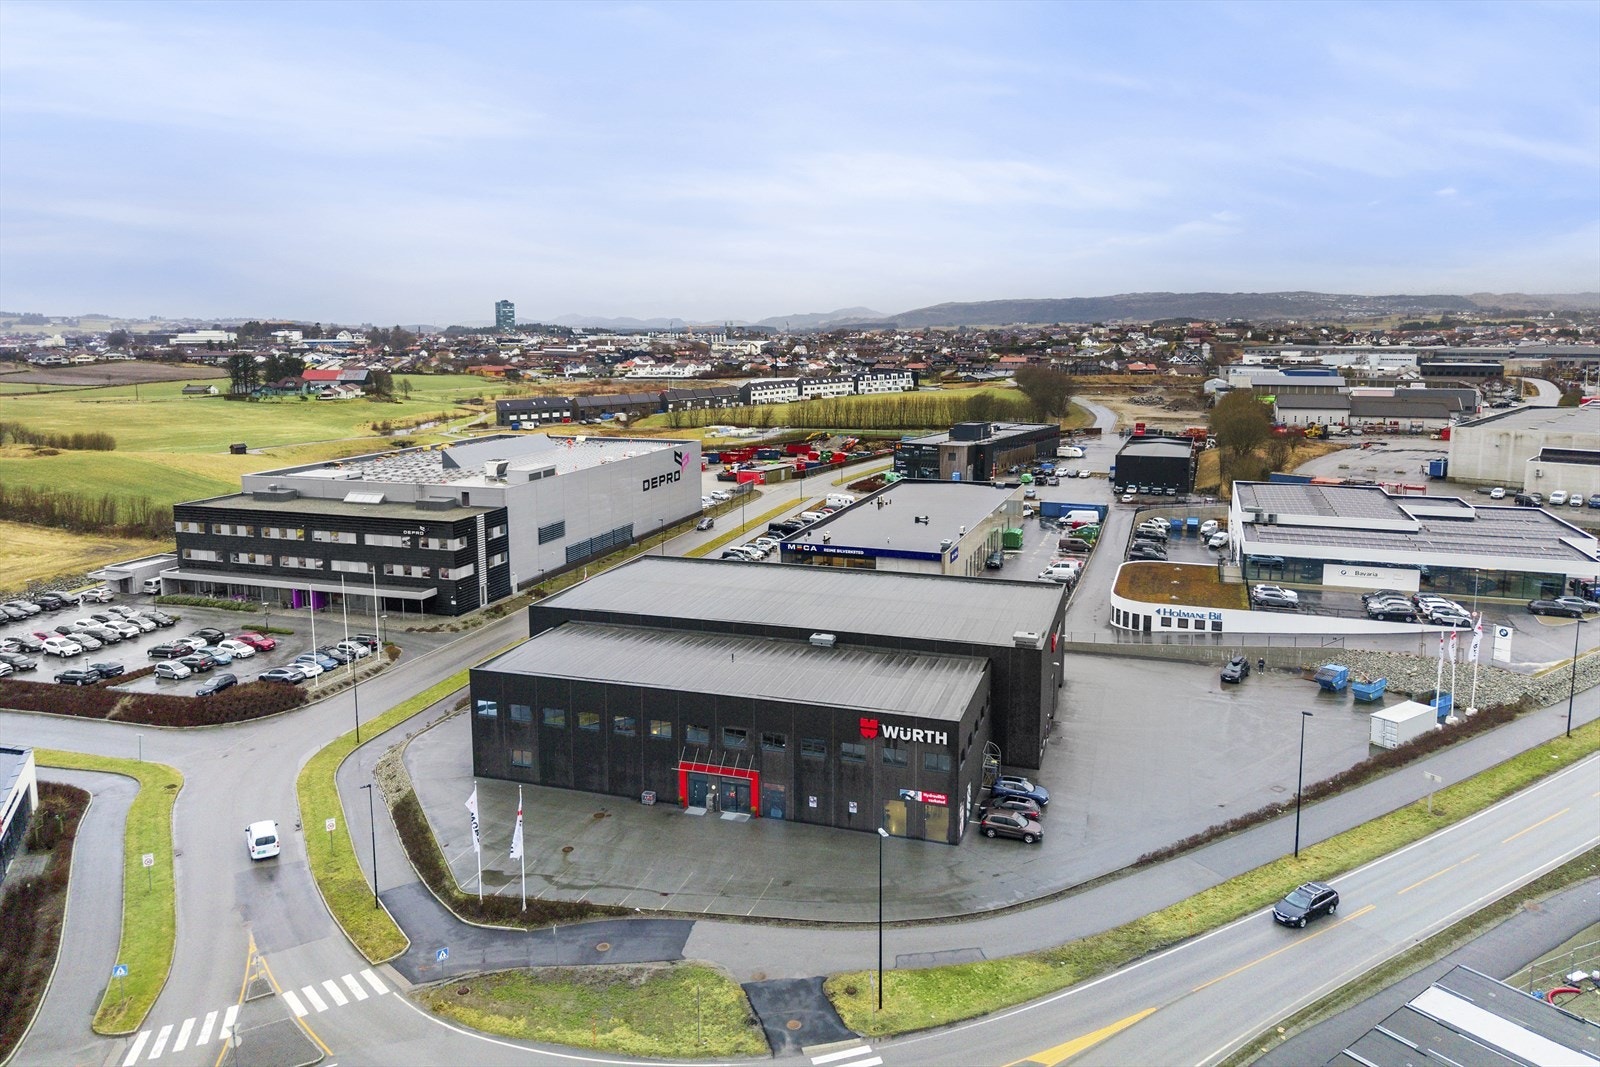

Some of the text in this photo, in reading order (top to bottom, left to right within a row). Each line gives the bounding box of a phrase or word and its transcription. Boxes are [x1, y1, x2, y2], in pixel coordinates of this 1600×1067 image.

[642, 469, 681, 492] DEPRO
[1208, 611, 1223, 621] Bil
[881, 723, 948, 746] WÜRTH
